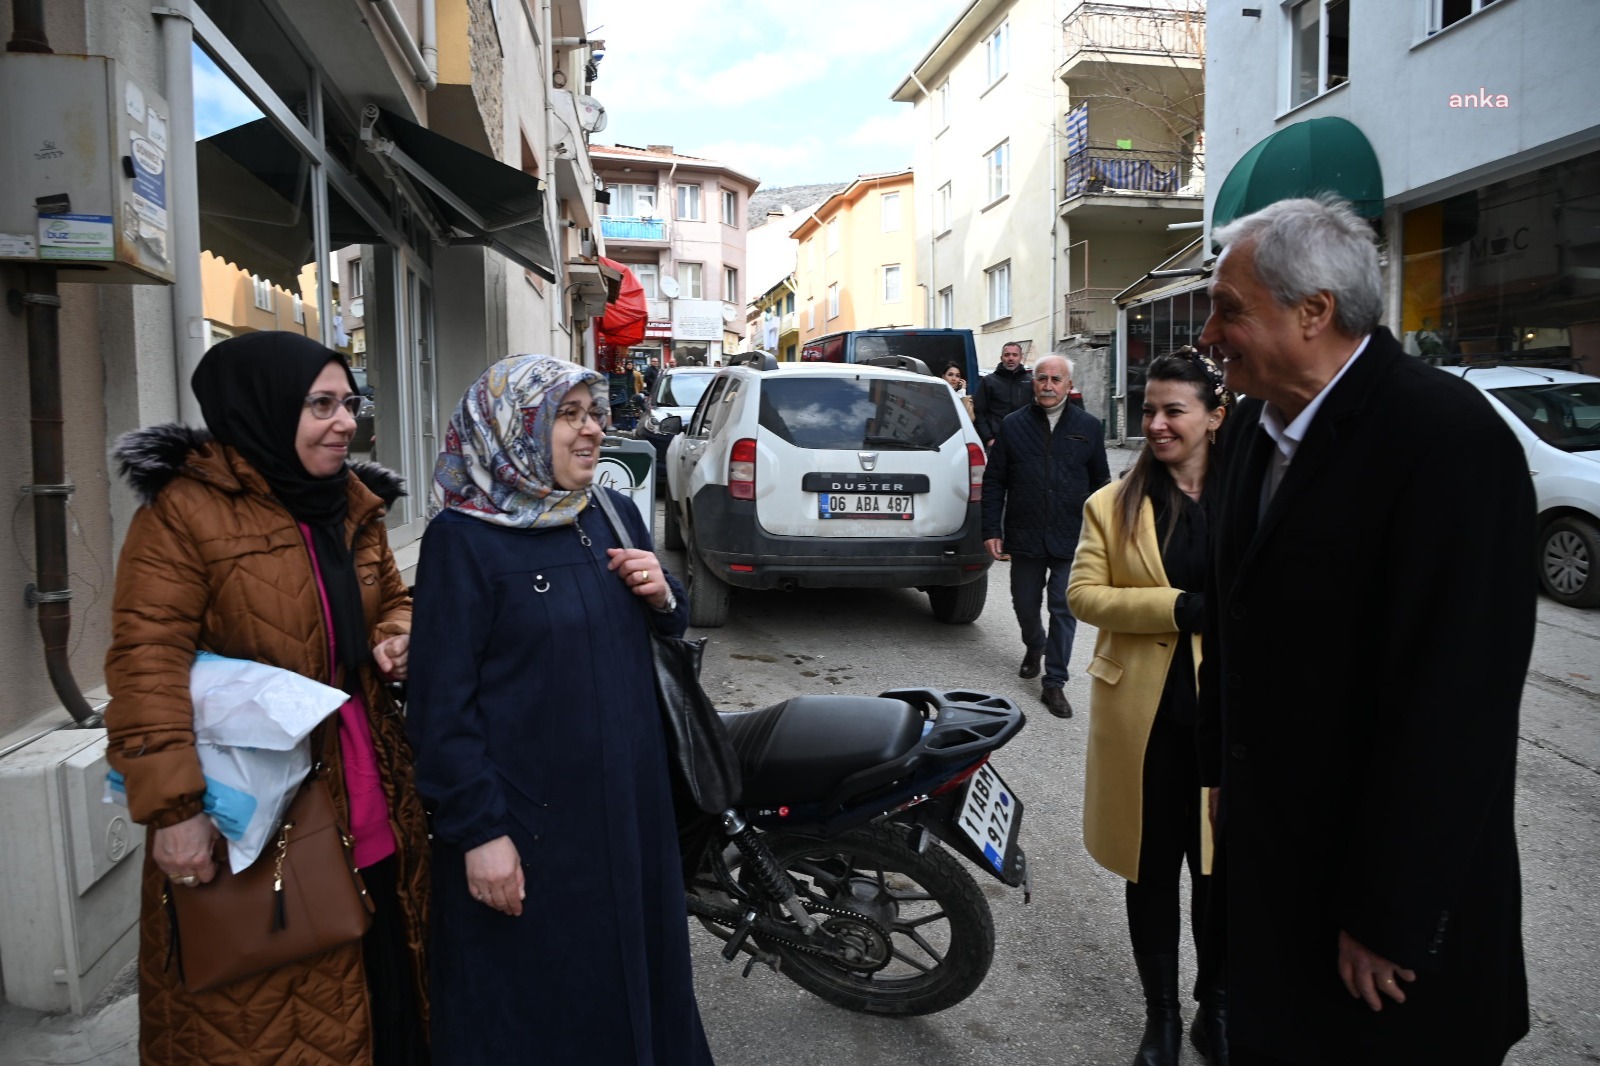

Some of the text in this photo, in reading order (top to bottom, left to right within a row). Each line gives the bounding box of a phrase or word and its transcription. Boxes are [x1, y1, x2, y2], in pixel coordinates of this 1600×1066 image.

[831, 482, 904, 491] DUSTER
[830, 496, 846, 511] 06
[855, 496, 880, 512] ABA
[887, 497, 911, 513] 487
[988, 801, 1009, 848] 972
